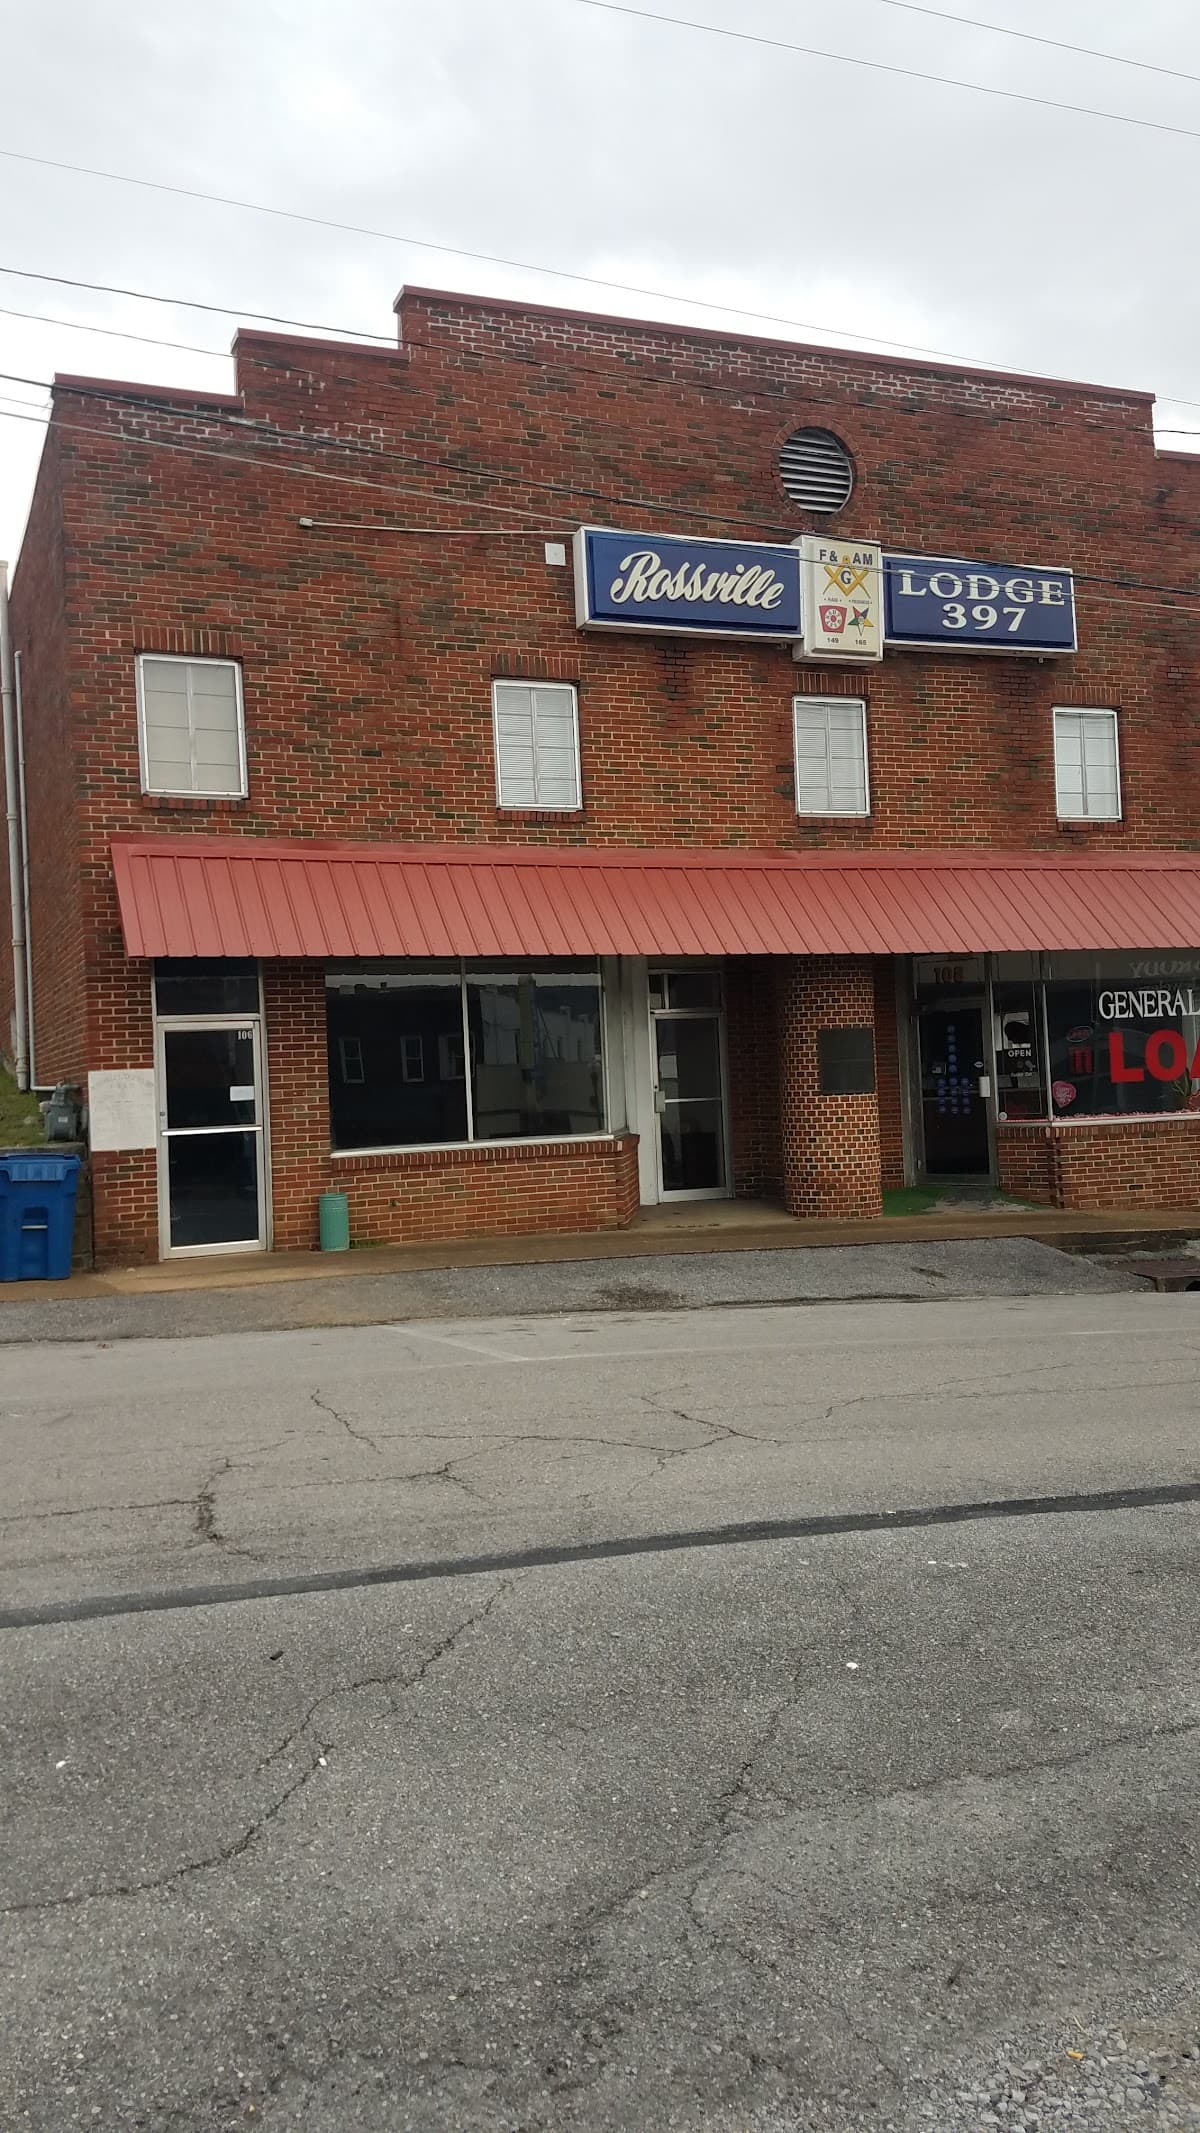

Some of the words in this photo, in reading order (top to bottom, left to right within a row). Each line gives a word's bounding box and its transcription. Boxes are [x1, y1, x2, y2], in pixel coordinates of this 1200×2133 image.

[853, 552, 873, 565] AM
[609, 551, 784, 609] Rossville
[840, 570, 852, 584] G
[898, 569, 1065, 605] LODGE
[941, 604, 1026, 632] 397
[1098, 989, 1200, 1019] GENERAL
[1007, 1049, 1032, 1058] OPEN
[1108, 1029, 1200, 1083] LO
